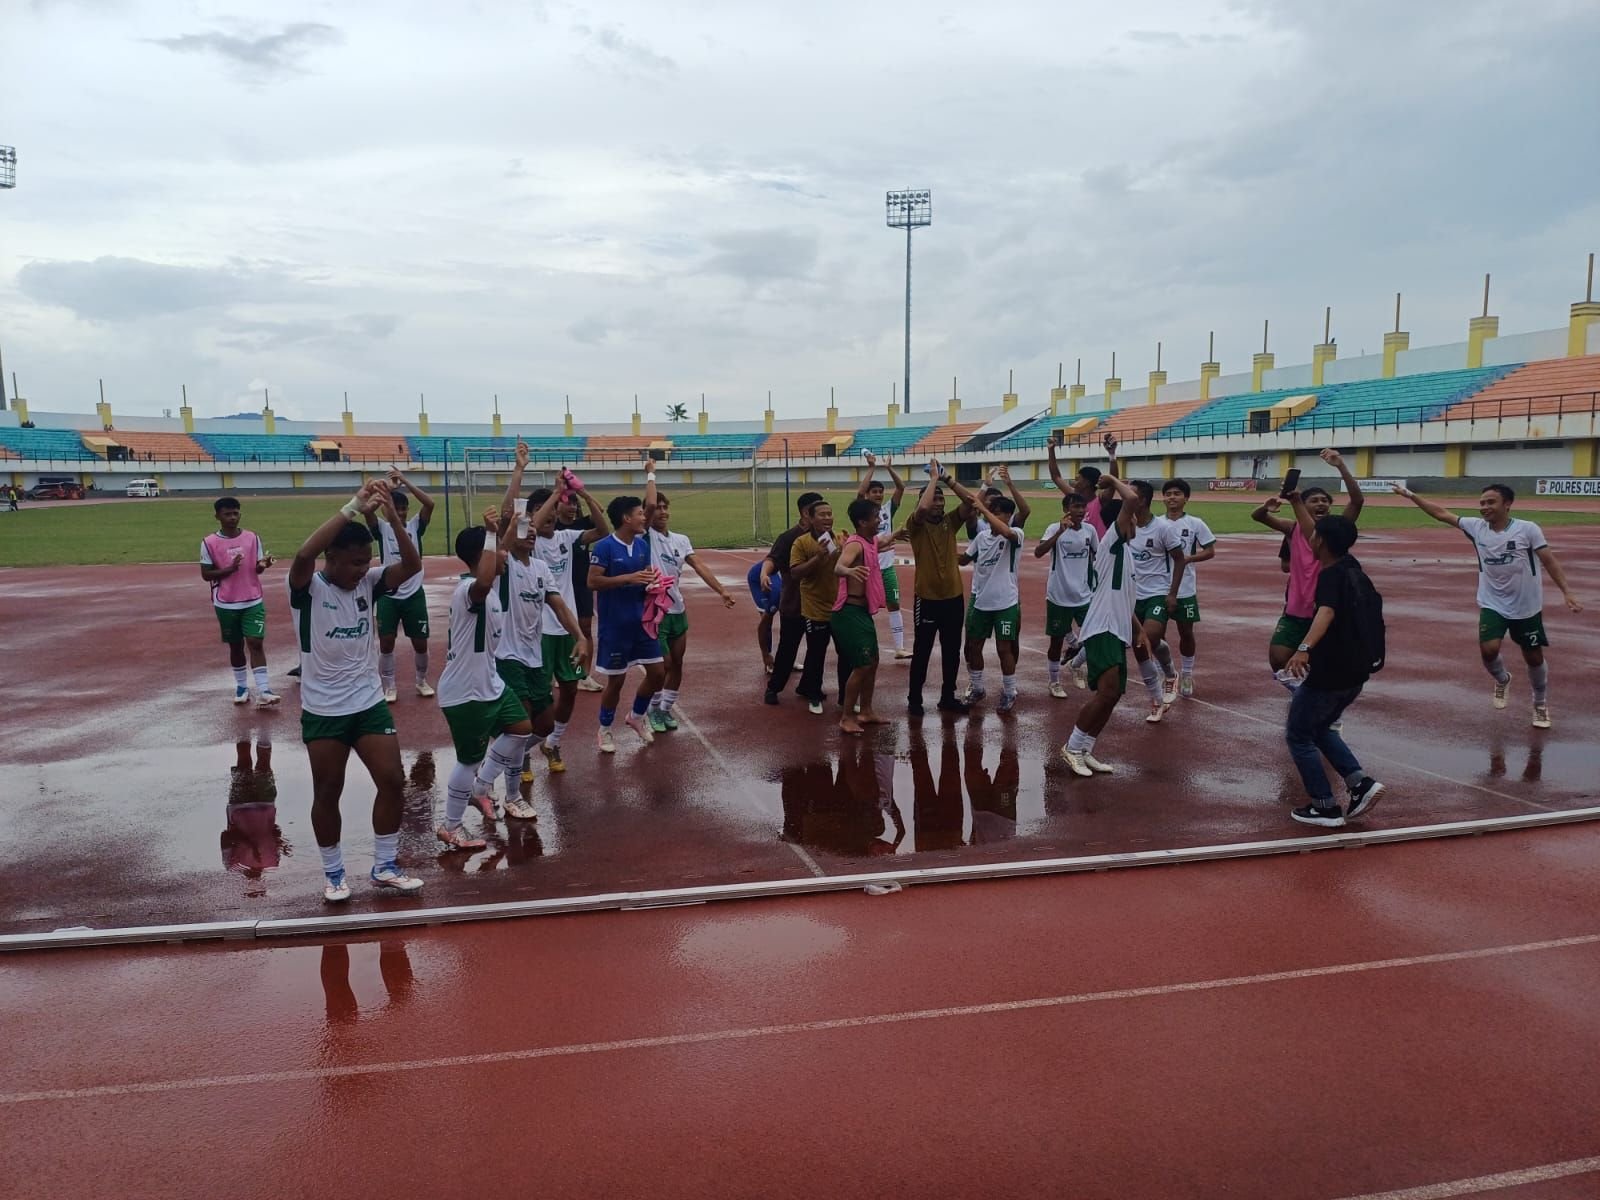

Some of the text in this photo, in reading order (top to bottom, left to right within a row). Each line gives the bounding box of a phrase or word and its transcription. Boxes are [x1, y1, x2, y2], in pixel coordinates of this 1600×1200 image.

[1549, 481, 1581, 493] POLRES
[1152, 605, 1161, 615] 8
[1186, 607, 1194, 618] 15
[257, 623, 263, 633] 7
[421, 624, 427, 633] 4
[1002, 624, 1010, 635] 16
[1529, 634, 1538, 646] 2
